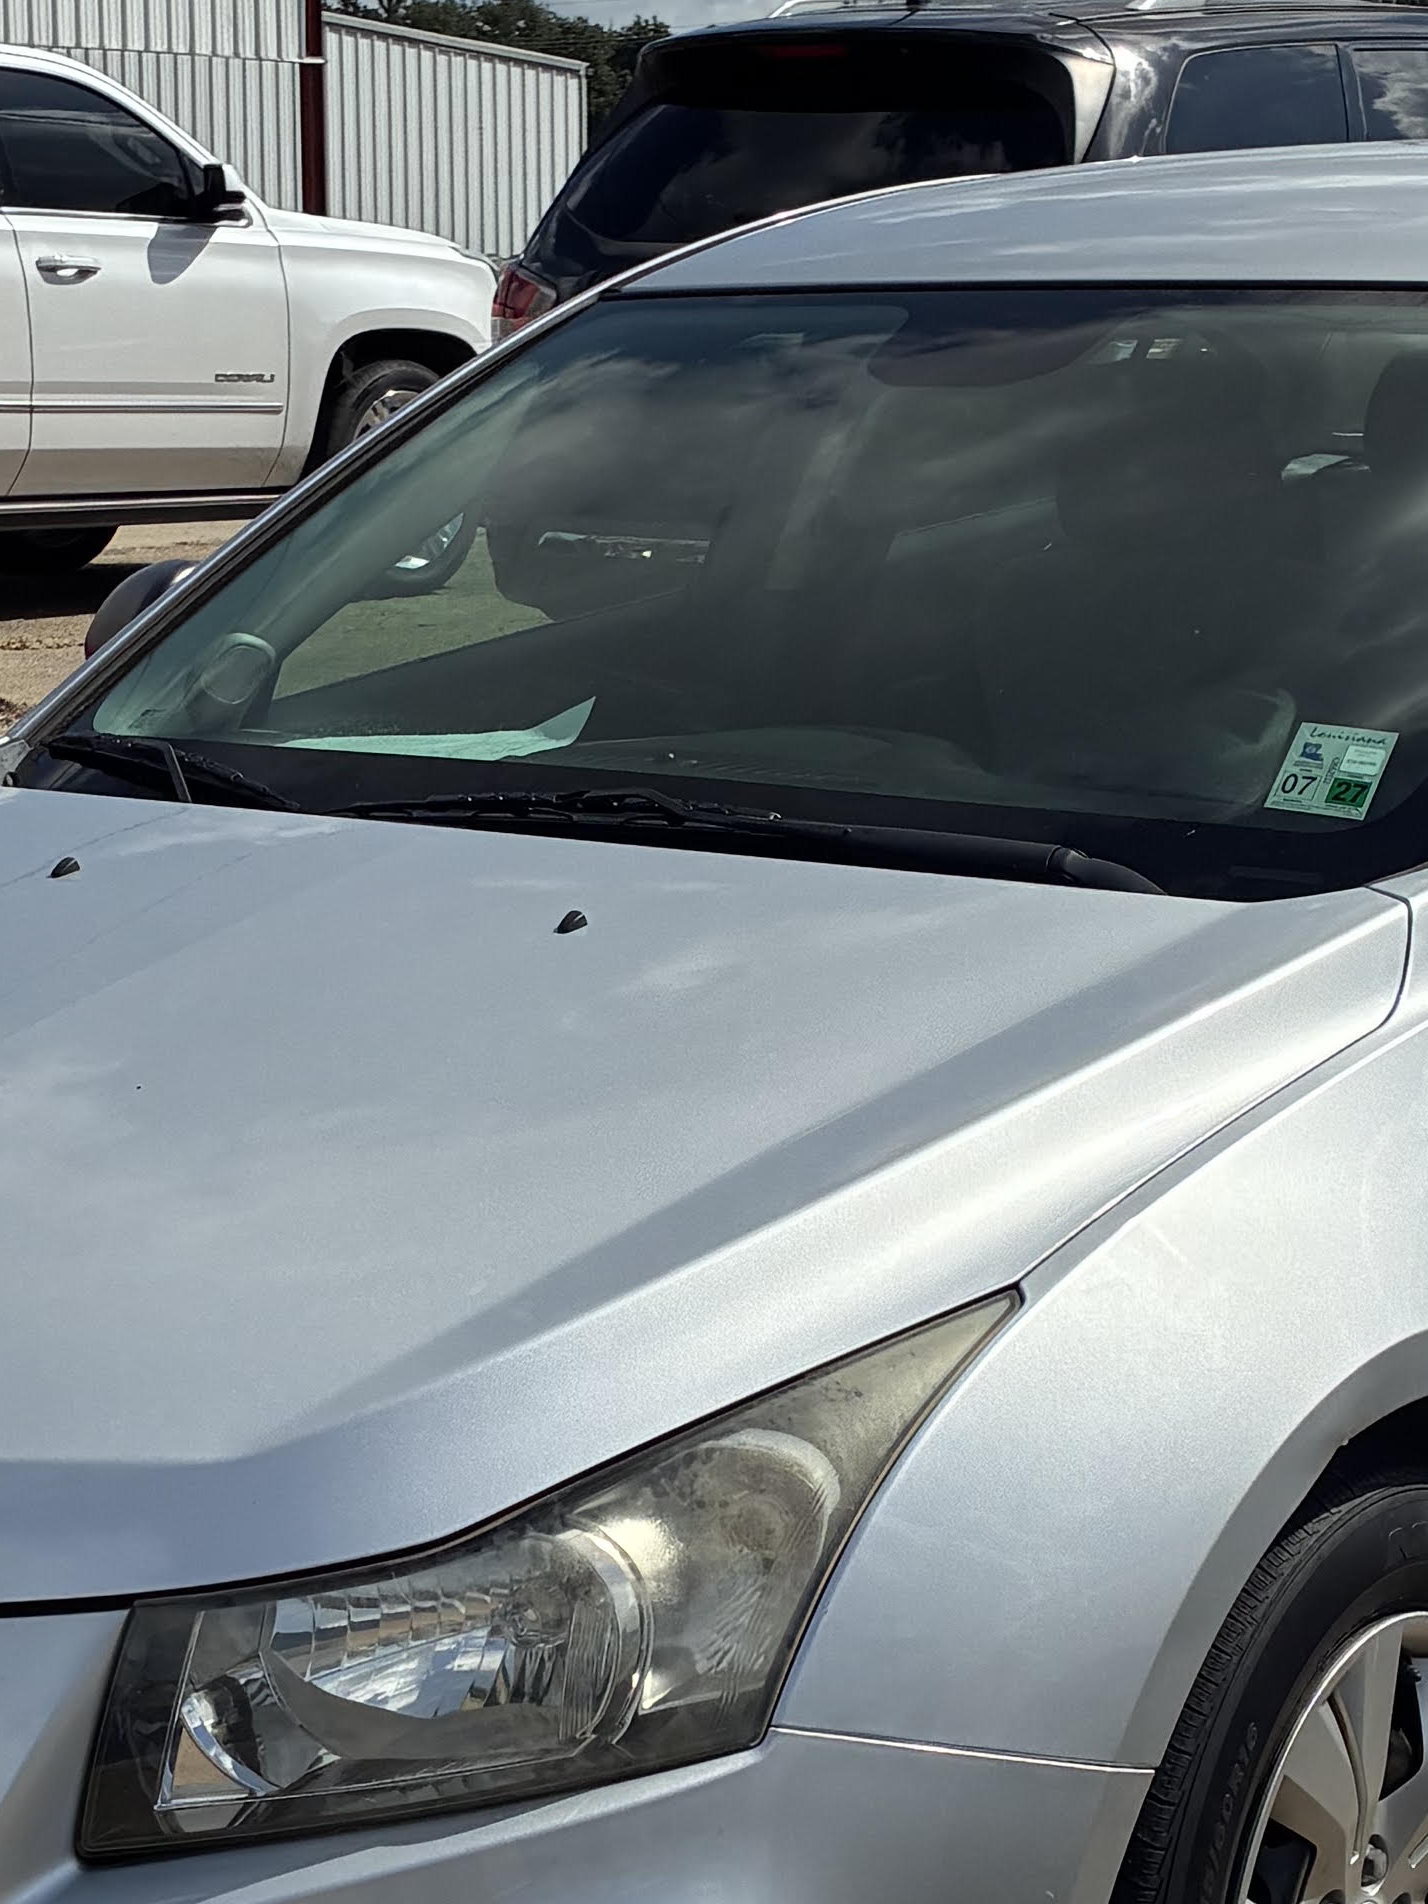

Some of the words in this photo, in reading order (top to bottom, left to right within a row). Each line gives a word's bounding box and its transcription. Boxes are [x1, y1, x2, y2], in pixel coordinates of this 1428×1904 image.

[1309, 726, 1388, 746] Louisiana
[1280, 772, 1318, 796] 07
[1331, 780, 1369, 804] 27
